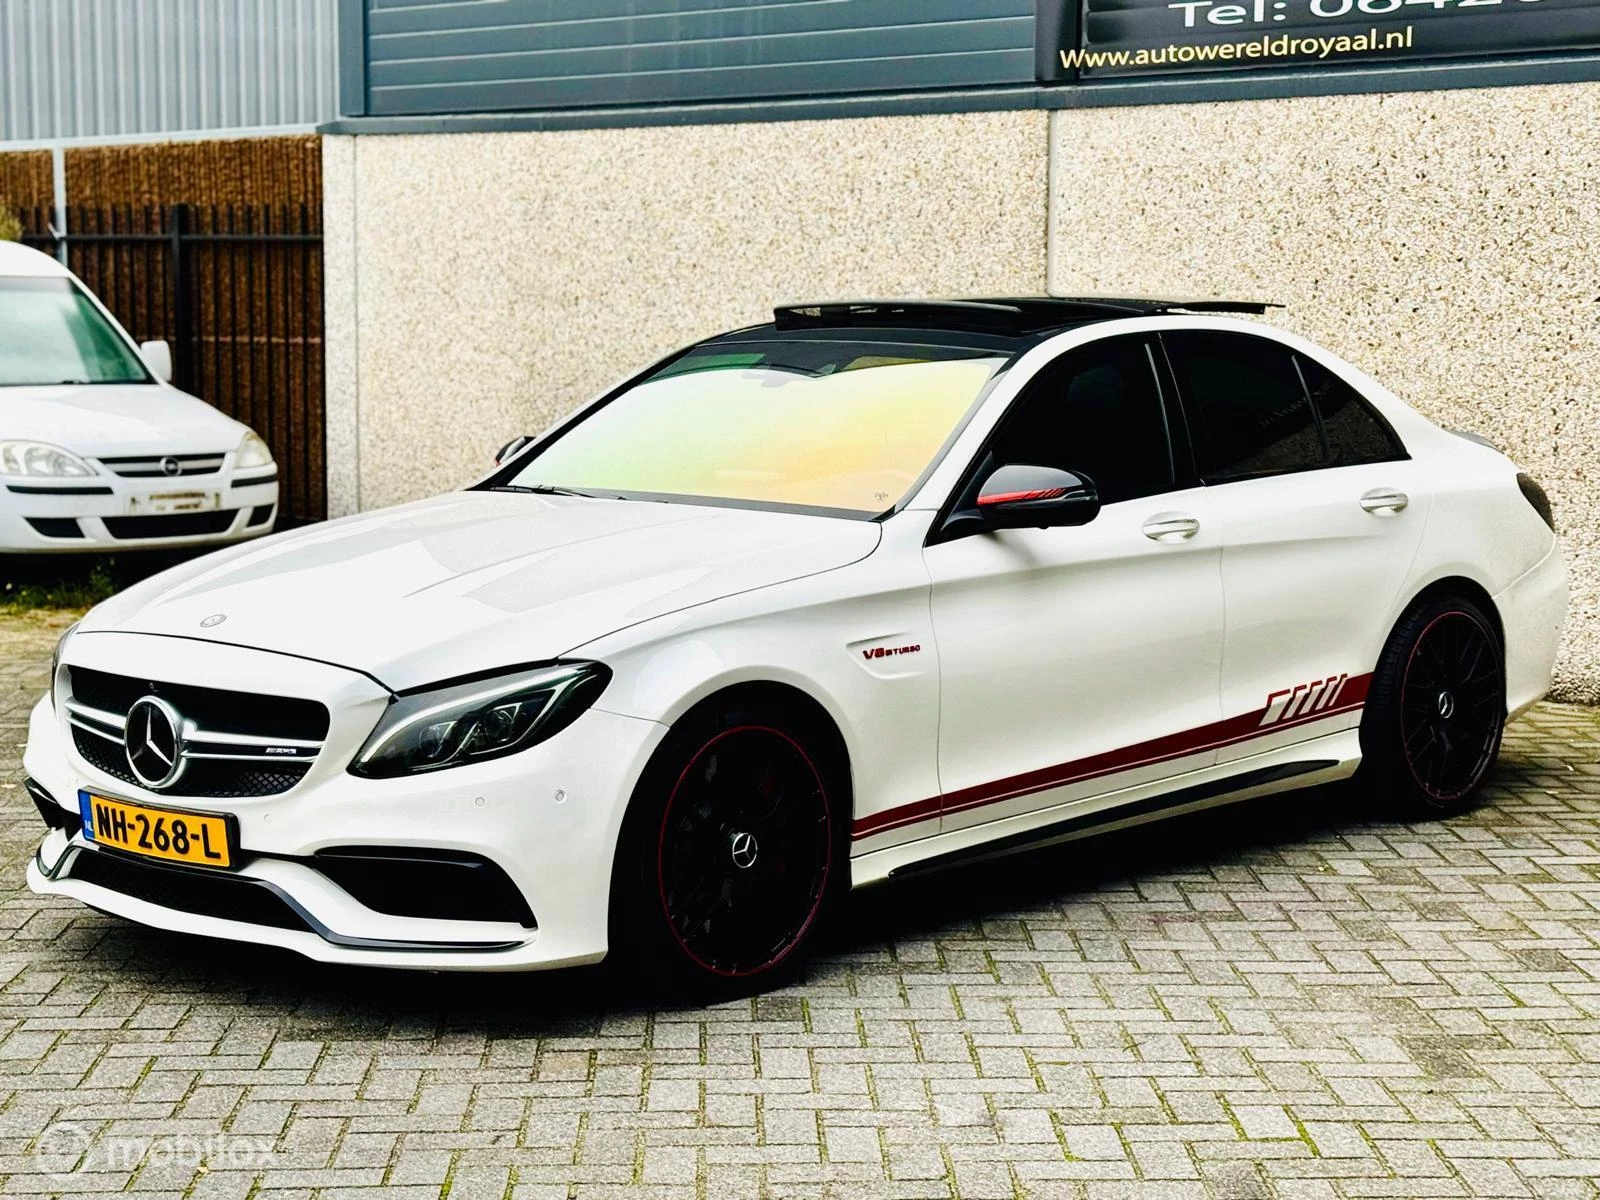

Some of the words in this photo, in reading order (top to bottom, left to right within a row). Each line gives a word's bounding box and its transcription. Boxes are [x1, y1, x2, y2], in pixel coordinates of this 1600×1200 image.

[1168, 0, 1286, 28] Tel:
[862, 647, 884, 660] V8
[95, 803, 222, 860] NH-268-L
